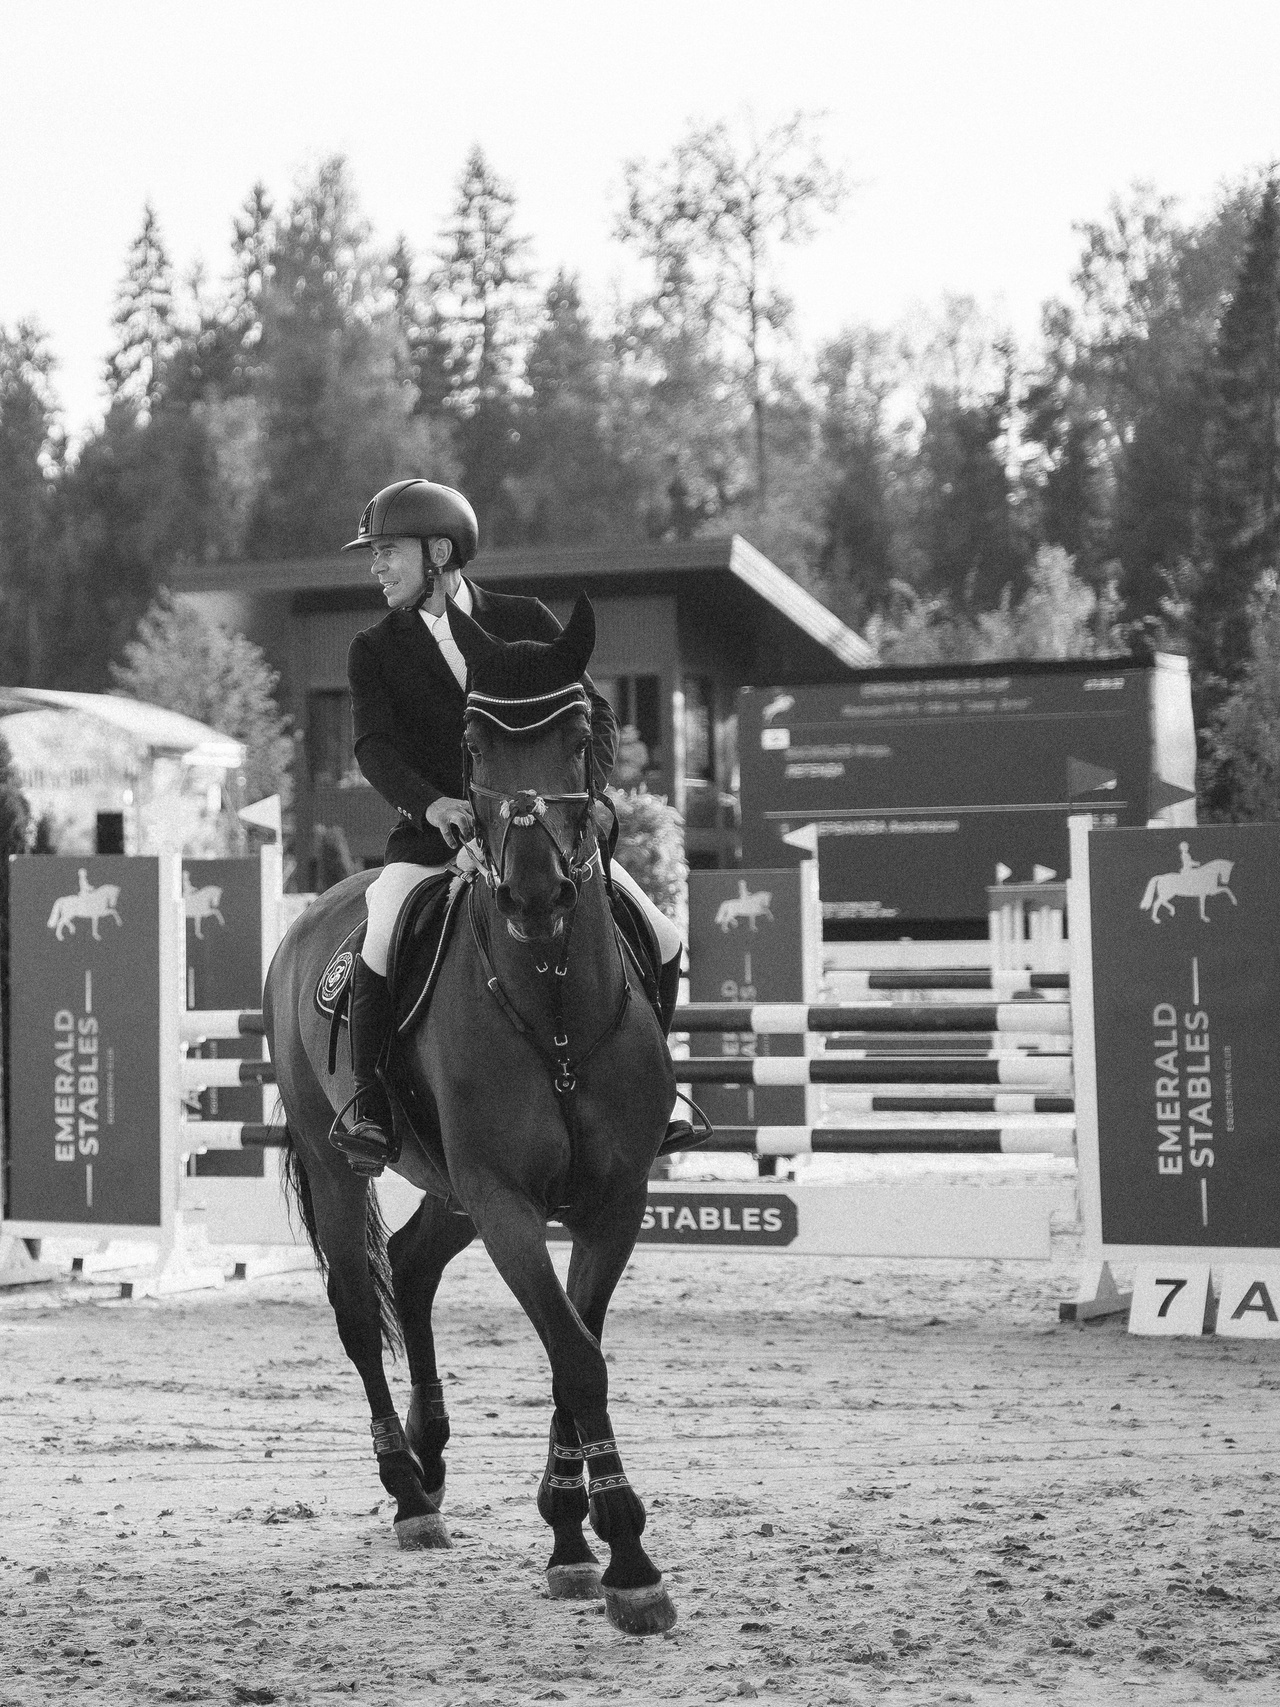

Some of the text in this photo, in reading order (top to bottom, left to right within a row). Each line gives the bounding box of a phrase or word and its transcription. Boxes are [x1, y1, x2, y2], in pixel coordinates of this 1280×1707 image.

[53, 1008, 76, 1162] EMERALD
[77, 1016, 100, 1156] STABLES
[1153, 1001, 1183, 1175] EMERALD
[1184, 1009, 1215, 1168] STABLES
[640, 1205, 783, 1232] STABLES
[1154, 1278, 1280, 1322] 7 A
